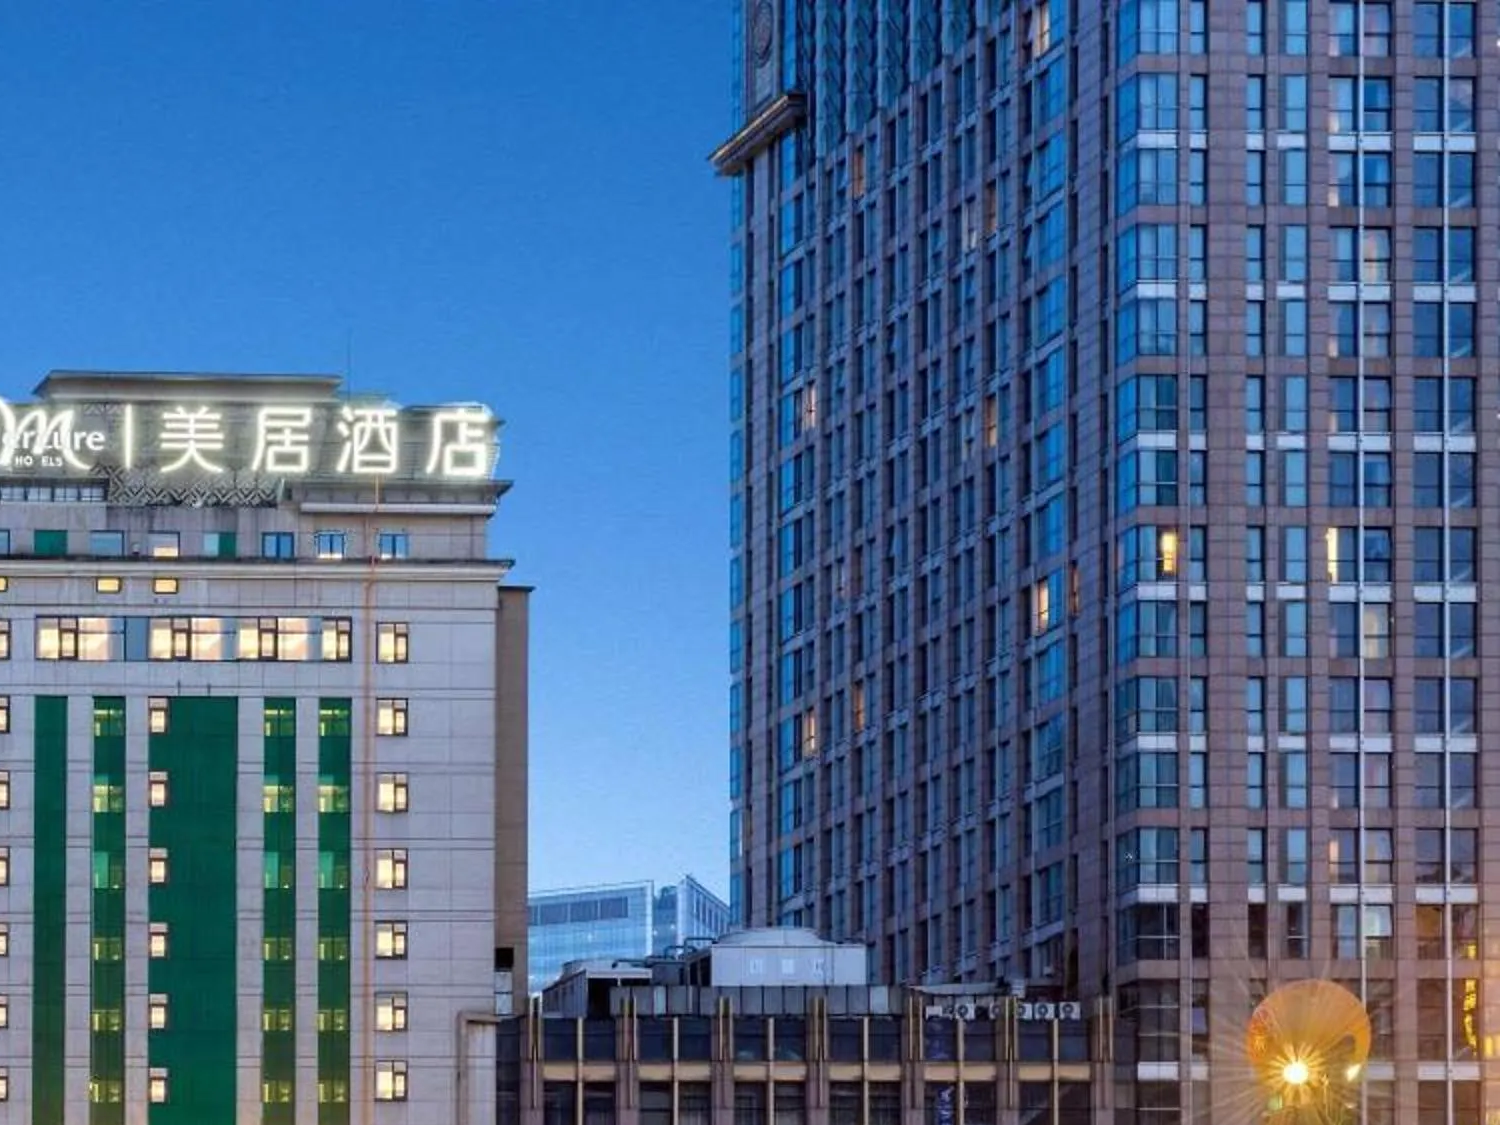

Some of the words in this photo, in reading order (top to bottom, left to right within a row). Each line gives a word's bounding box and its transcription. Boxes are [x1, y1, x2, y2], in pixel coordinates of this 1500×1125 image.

[14, 455, 63, 467] HOELS
[159, 405, 493, 477] 美居酒店
